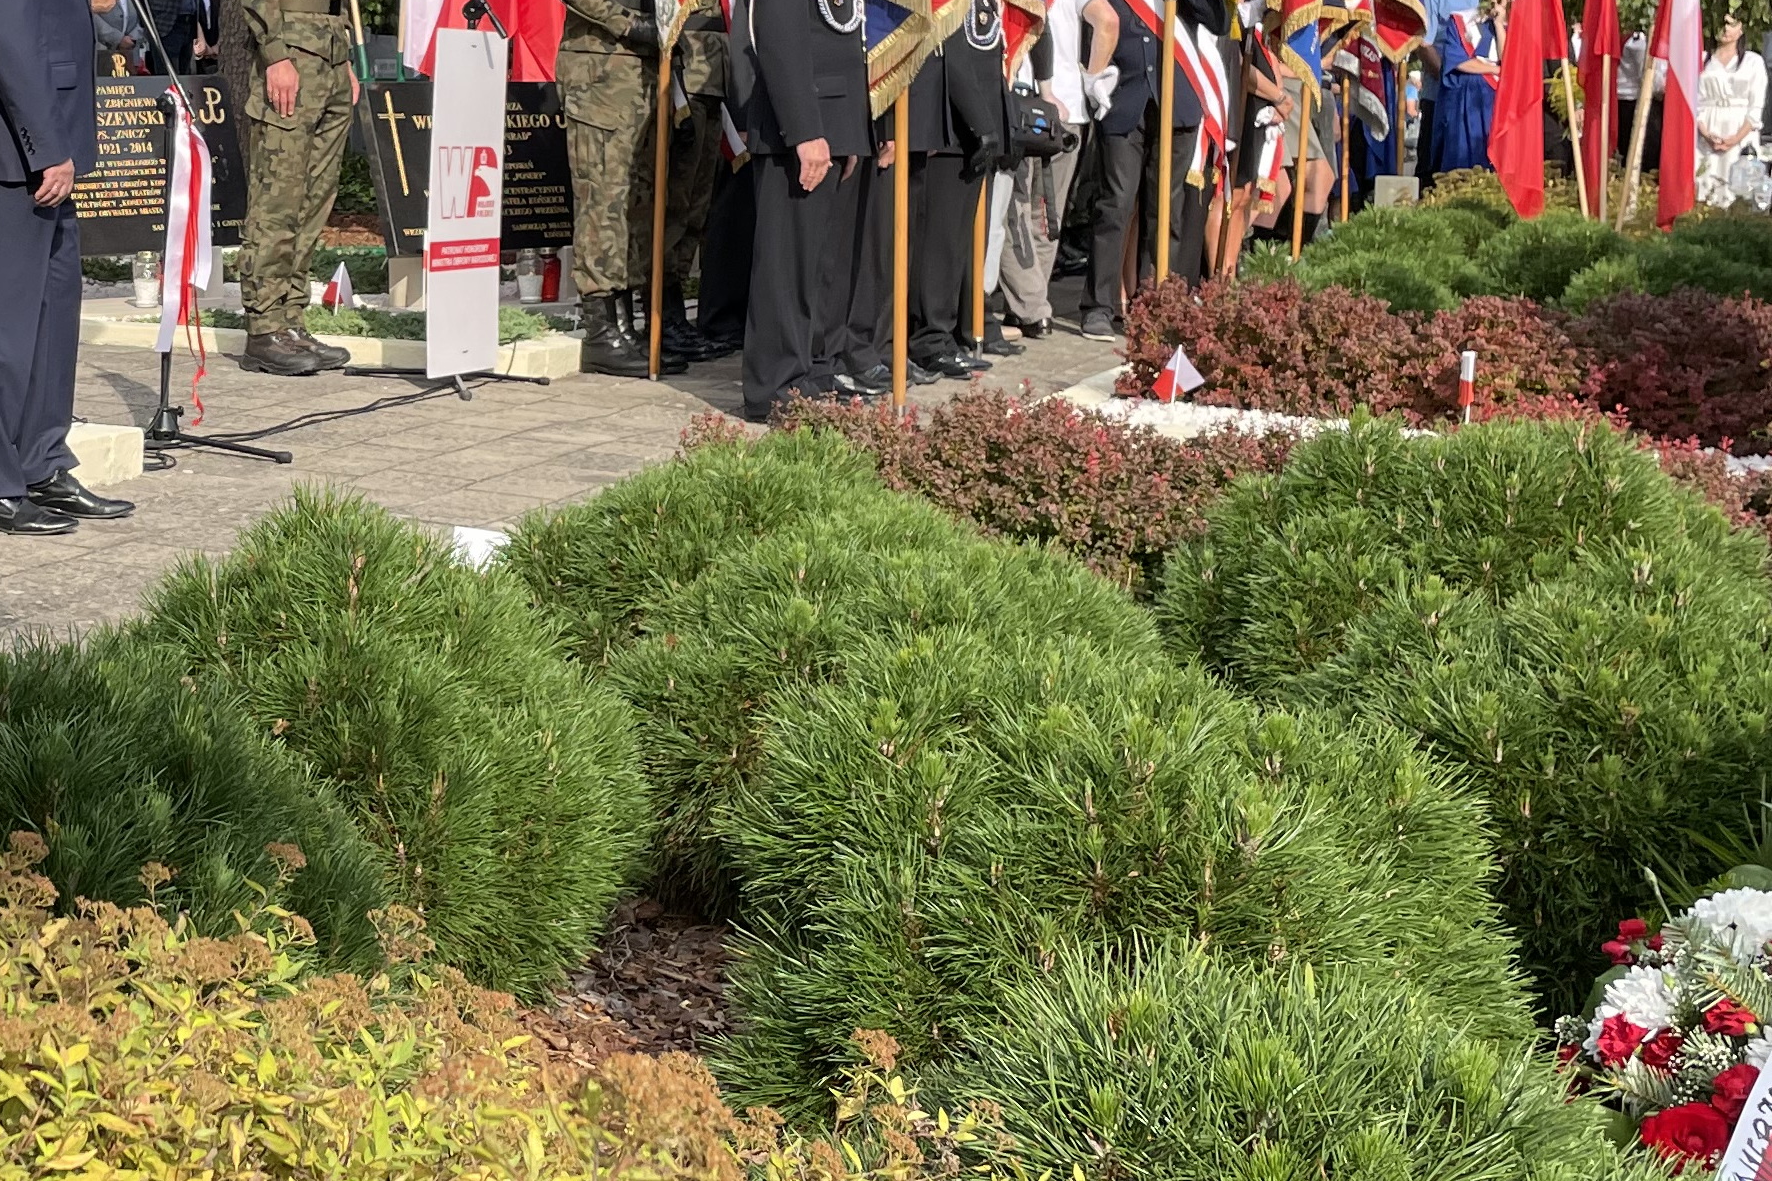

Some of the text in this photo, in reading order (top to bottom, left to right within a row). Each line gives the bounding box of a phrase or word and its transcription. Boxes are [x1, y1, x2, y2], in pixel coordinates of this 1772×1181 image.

[104, 97, 157, 109] ZBIGNIEWA
[96, 110, 166, 126] SZEWSKI
[98, 143, 121, 155] 1921
[129, 141, 153, 154] 2014
